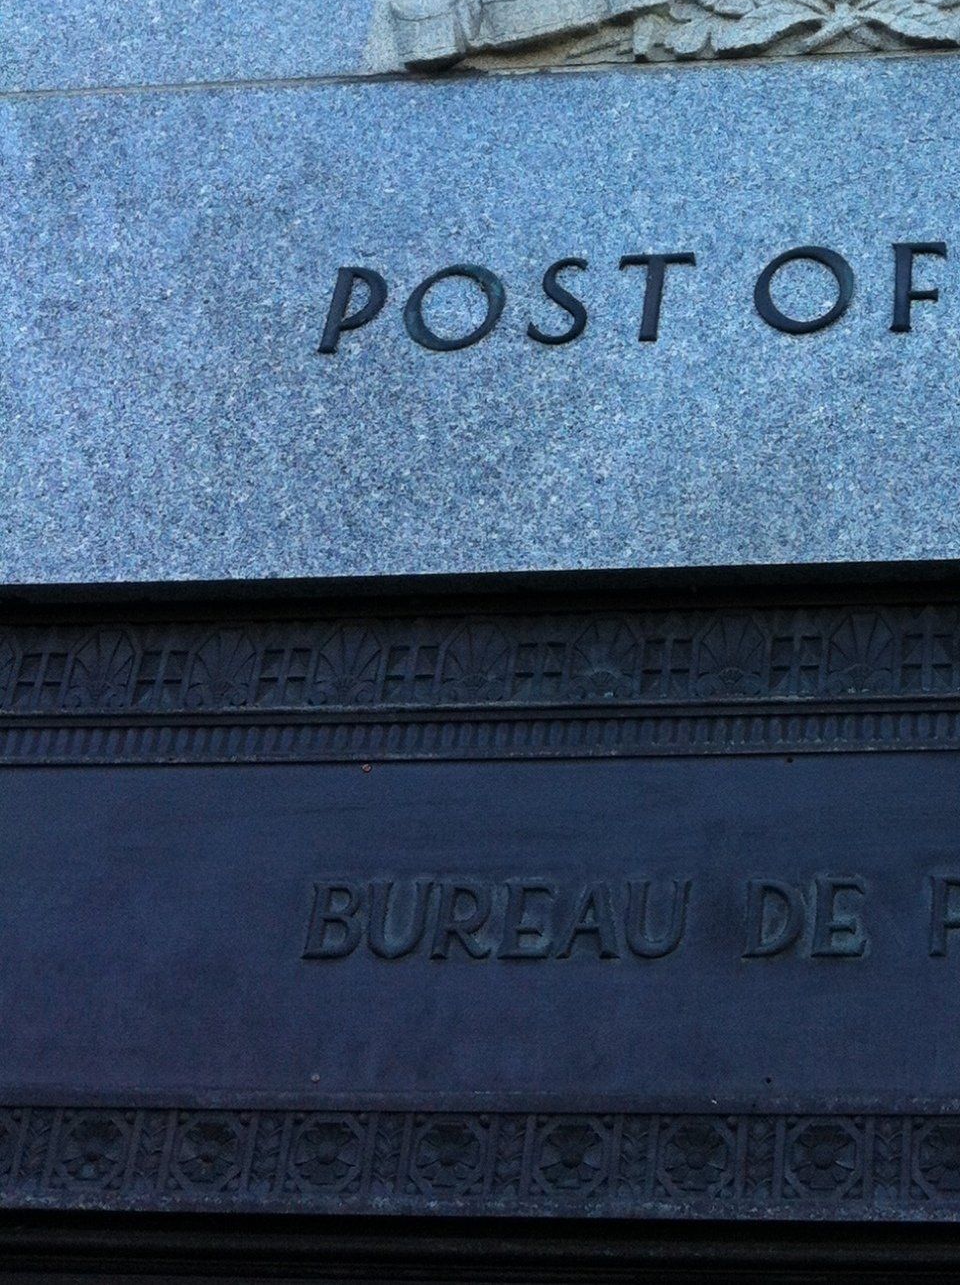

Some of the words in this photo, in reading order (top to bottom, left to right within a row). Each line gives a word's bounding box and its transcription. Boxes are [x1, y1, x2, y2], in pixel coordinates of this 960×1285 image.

[317, 252, 697, 354] POST
[301, 879, 694, 960] BUREAU
[741, 875, 868, 959] DE
